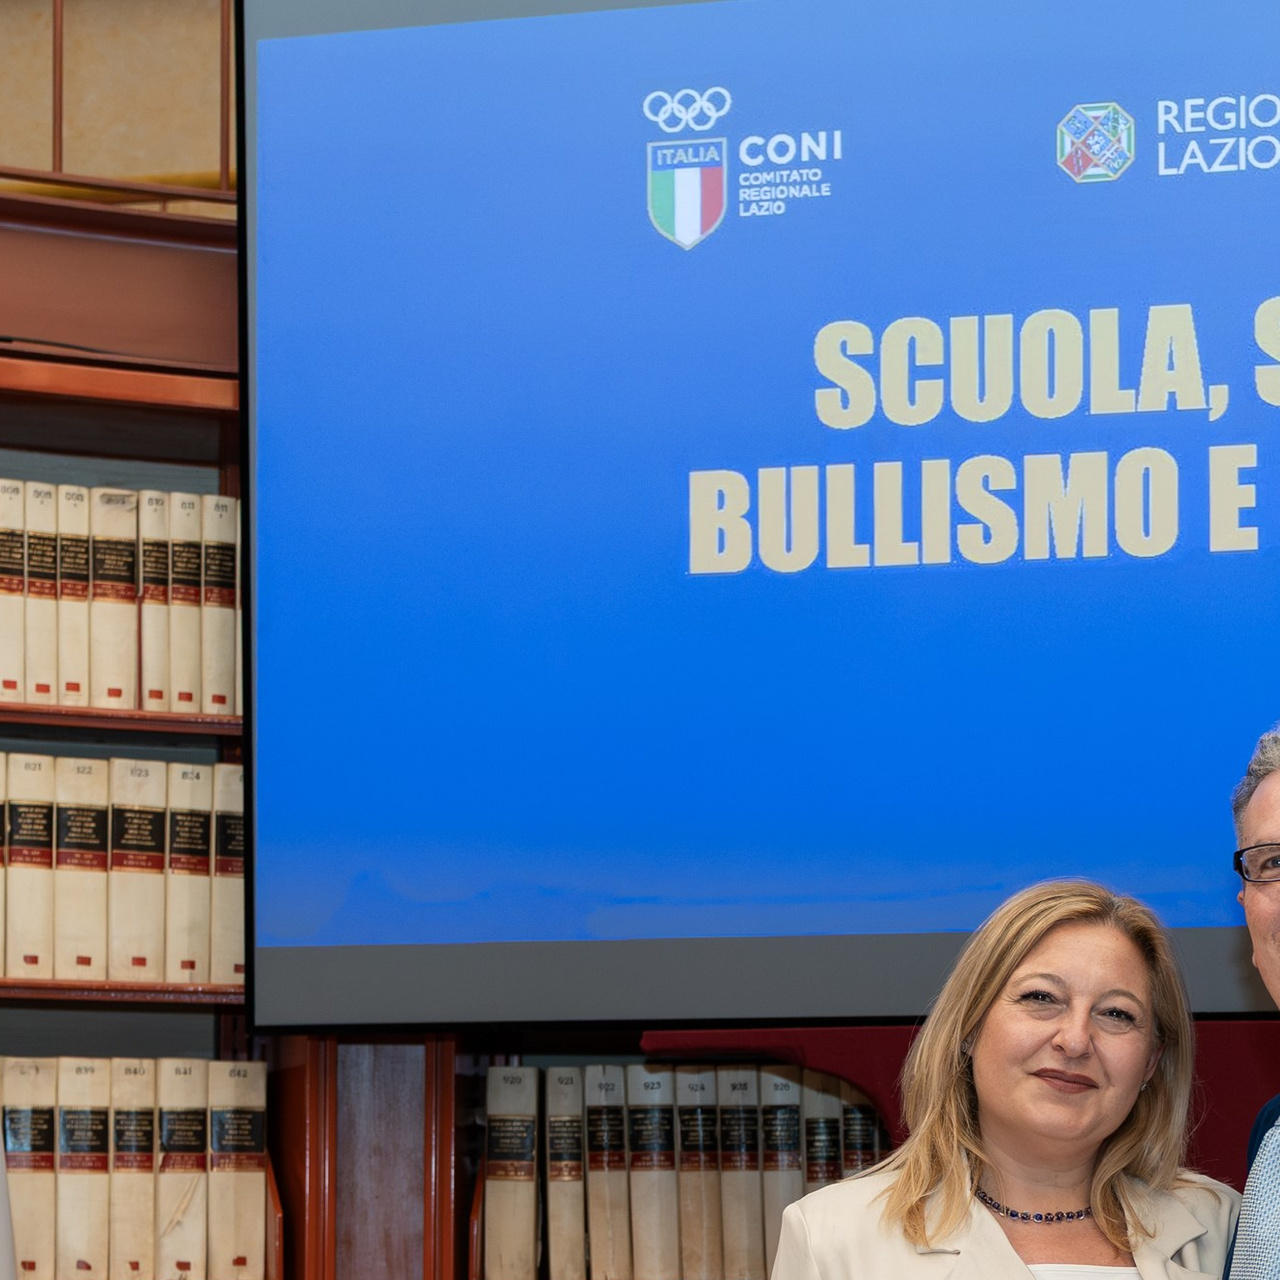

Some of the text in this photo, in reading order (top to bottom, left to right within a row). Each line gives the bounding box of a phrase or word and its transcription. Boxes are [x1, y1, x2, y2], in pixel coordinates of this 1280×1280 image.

[657, 146, 720, 166] ITALIA
[739, 130, 842, 166] CONI
[739, 168, 822, 186] COMITATO
[739, 183, 831, 201] REGIONALE
[739, 201, 786, 217] LAZIO
[813, 304, 1228, 431] SCUOLA,
[686, 446, 1180, 575] BULLISMO
[1208, 444, 1259, 555] E
[503, 1075, 522, 1085] 920
